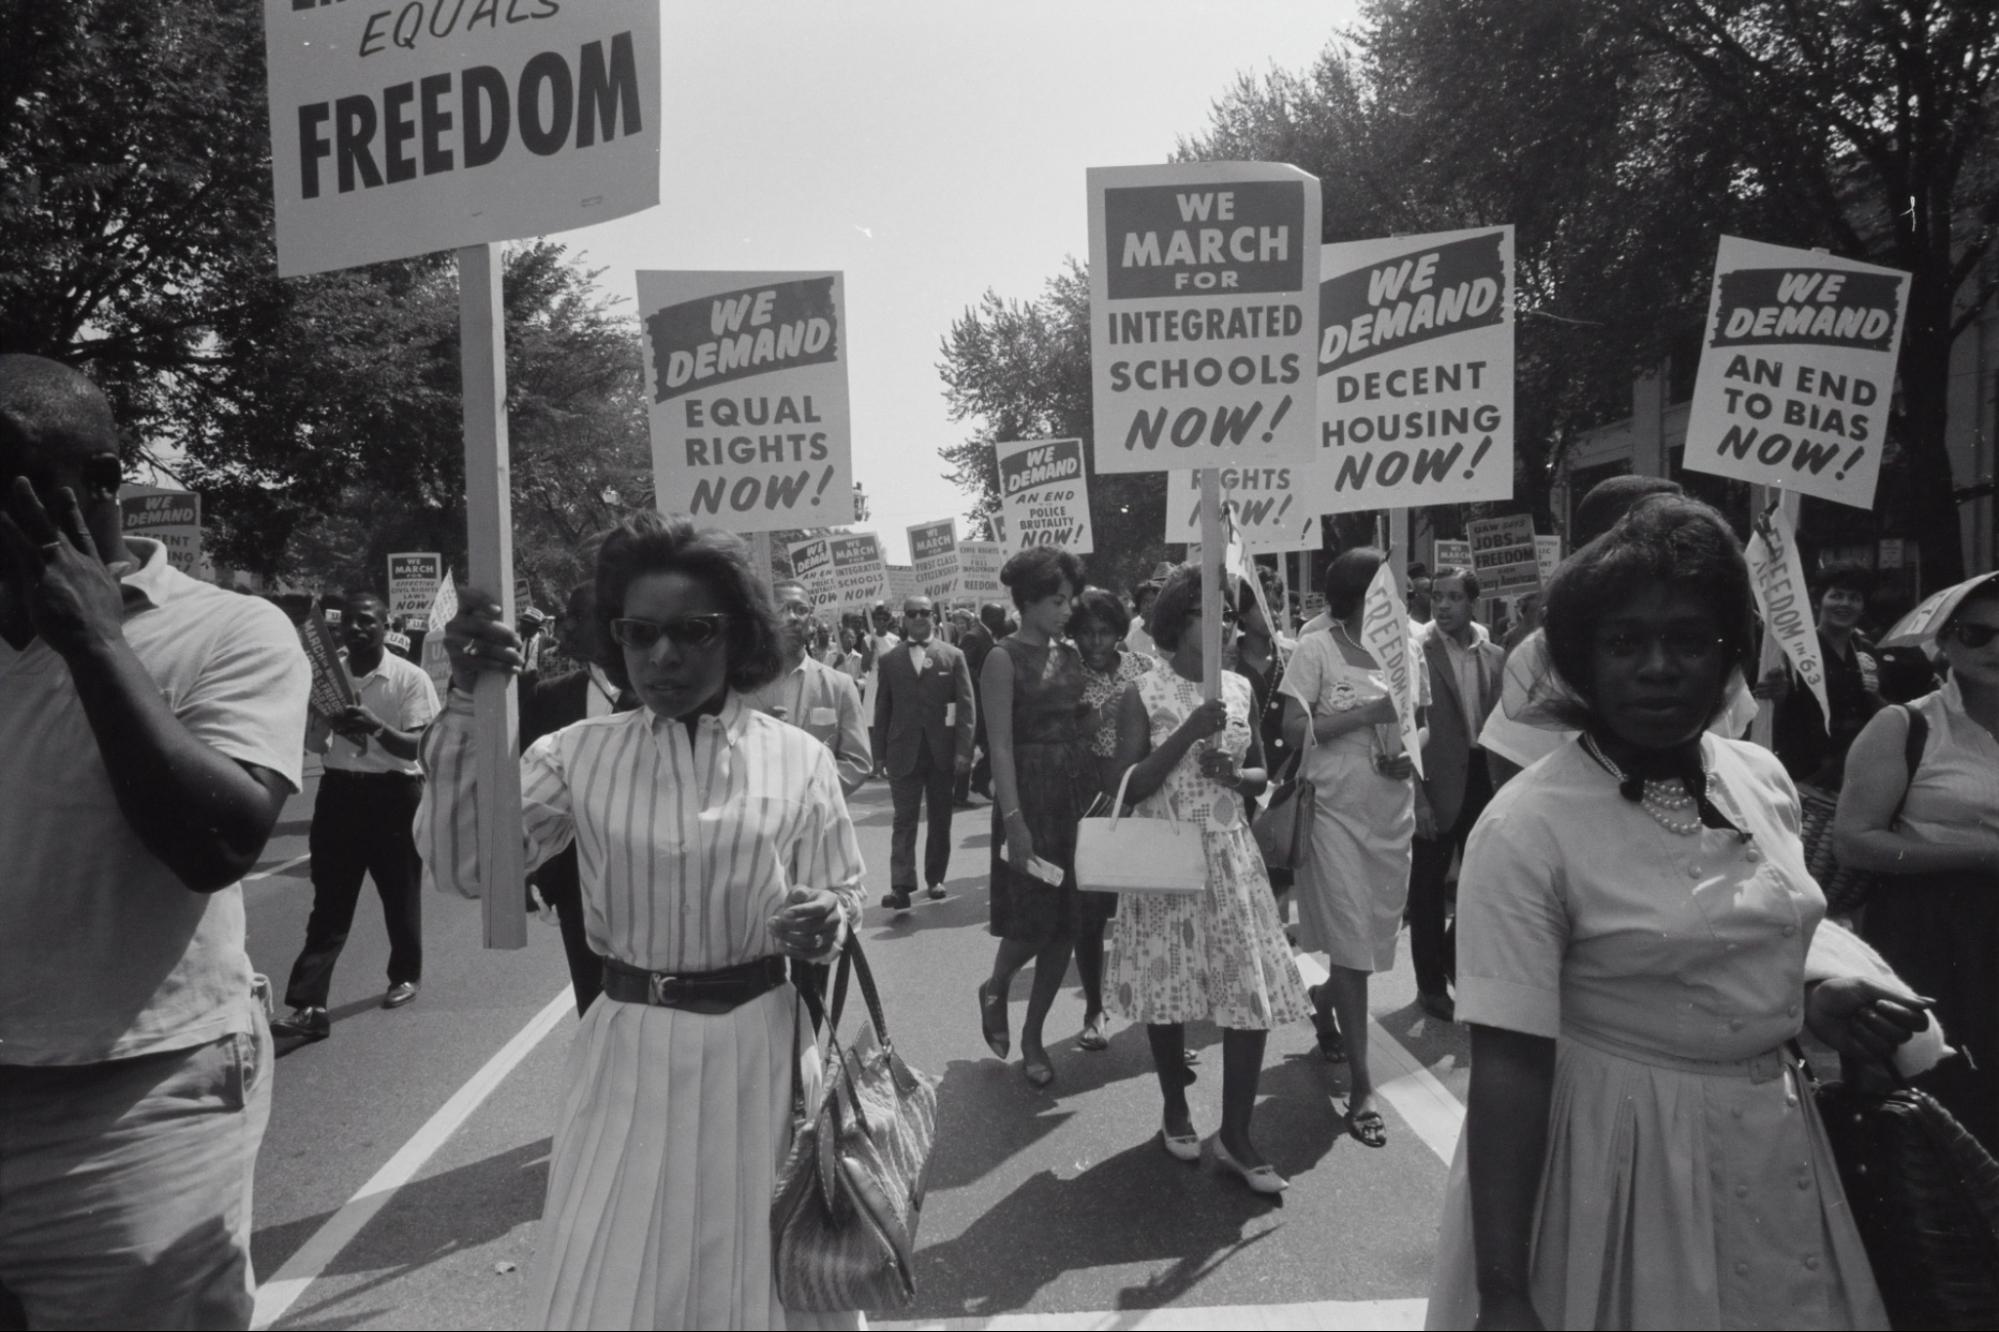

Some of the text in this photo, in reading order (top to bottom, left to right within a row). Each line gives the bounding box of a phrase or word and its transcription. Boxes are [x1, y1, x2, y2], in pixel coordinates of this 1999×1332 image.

[298, 30, 642, 199] FREEDOM
[1176, 192, 1235, 222] WE
[1122, 225, 1289, 268] MARCH
[1175, 270, 1239, 290] FOR
[1368, 252, 1440, 307] WE
[1776, 272, 1846, 304] WE
[710, 290, 776, 336] WE
[1108, 304, 1303, 345] INTEGRATED
[1319, 277, 1498, 364] DEMAND
[1724, 305, 1891, 340] DEMAND
[666, 318, 830, 388] DEMAND
[1110, 353, 1299, 392] SCHOOLS
[1337, 361, 1487, 403] DECENT
[1724, 354, 1877, 407] AN END
[685, 395, 821, 428] EQUAL
[1124, 394, 1293, 451] NOW!
[1322, 404, 1501, 448] HOUSING
[1724, 387, 1869, 442] TO BIAS
[685, 432, 828, 467] RIGHTS
[1026, 446, 1055, 468] WE
[1334, 435, 1493, 493] NOW!
[1716, 424, 1865, 481] NOW!
[690, 464, 834, 515] NOW!
[1008, 457, 1078, 492] DEMAND
[1191, 467, 1291, 490] RGHTS
[146, 496, 173, 510] WE
[1015, 490, 1075, 504] AN END
[1030, 506, 1066, 518] POLICE
[127, 508, 194, 527] DEMAND
[1019, 517, 1074, 530] BRUTALITY
[1474, 523, 1499, 534] UAW
[806, 541, 825, 557] WE
[916, 534, 951, 551] MARCH
[1021, 523, 1084, 548] NOW!
[1474, 533, 1513, 551] JOBS
[836, 545, 875, 560] MARCH
[916, 553, 957, 572] FIRST CLASS
[1475, 547, 1534, 568] FREEDOM
[395, 566, 434, 574] MARCH
[819, 569, 833, 577] EN
[835, 562, 882, 577] INTEGRATED
[838, 573, 884, 588] SCHOOLS
[915, 565, 959, 583] CITIZENSHIP
[844, 583, 884, 601] NOW!
[924, 578, 958, 597] NOW!
[304, 618, 328, 662] MARCH
[1364, 586, 1408, 696] FREEDOM
